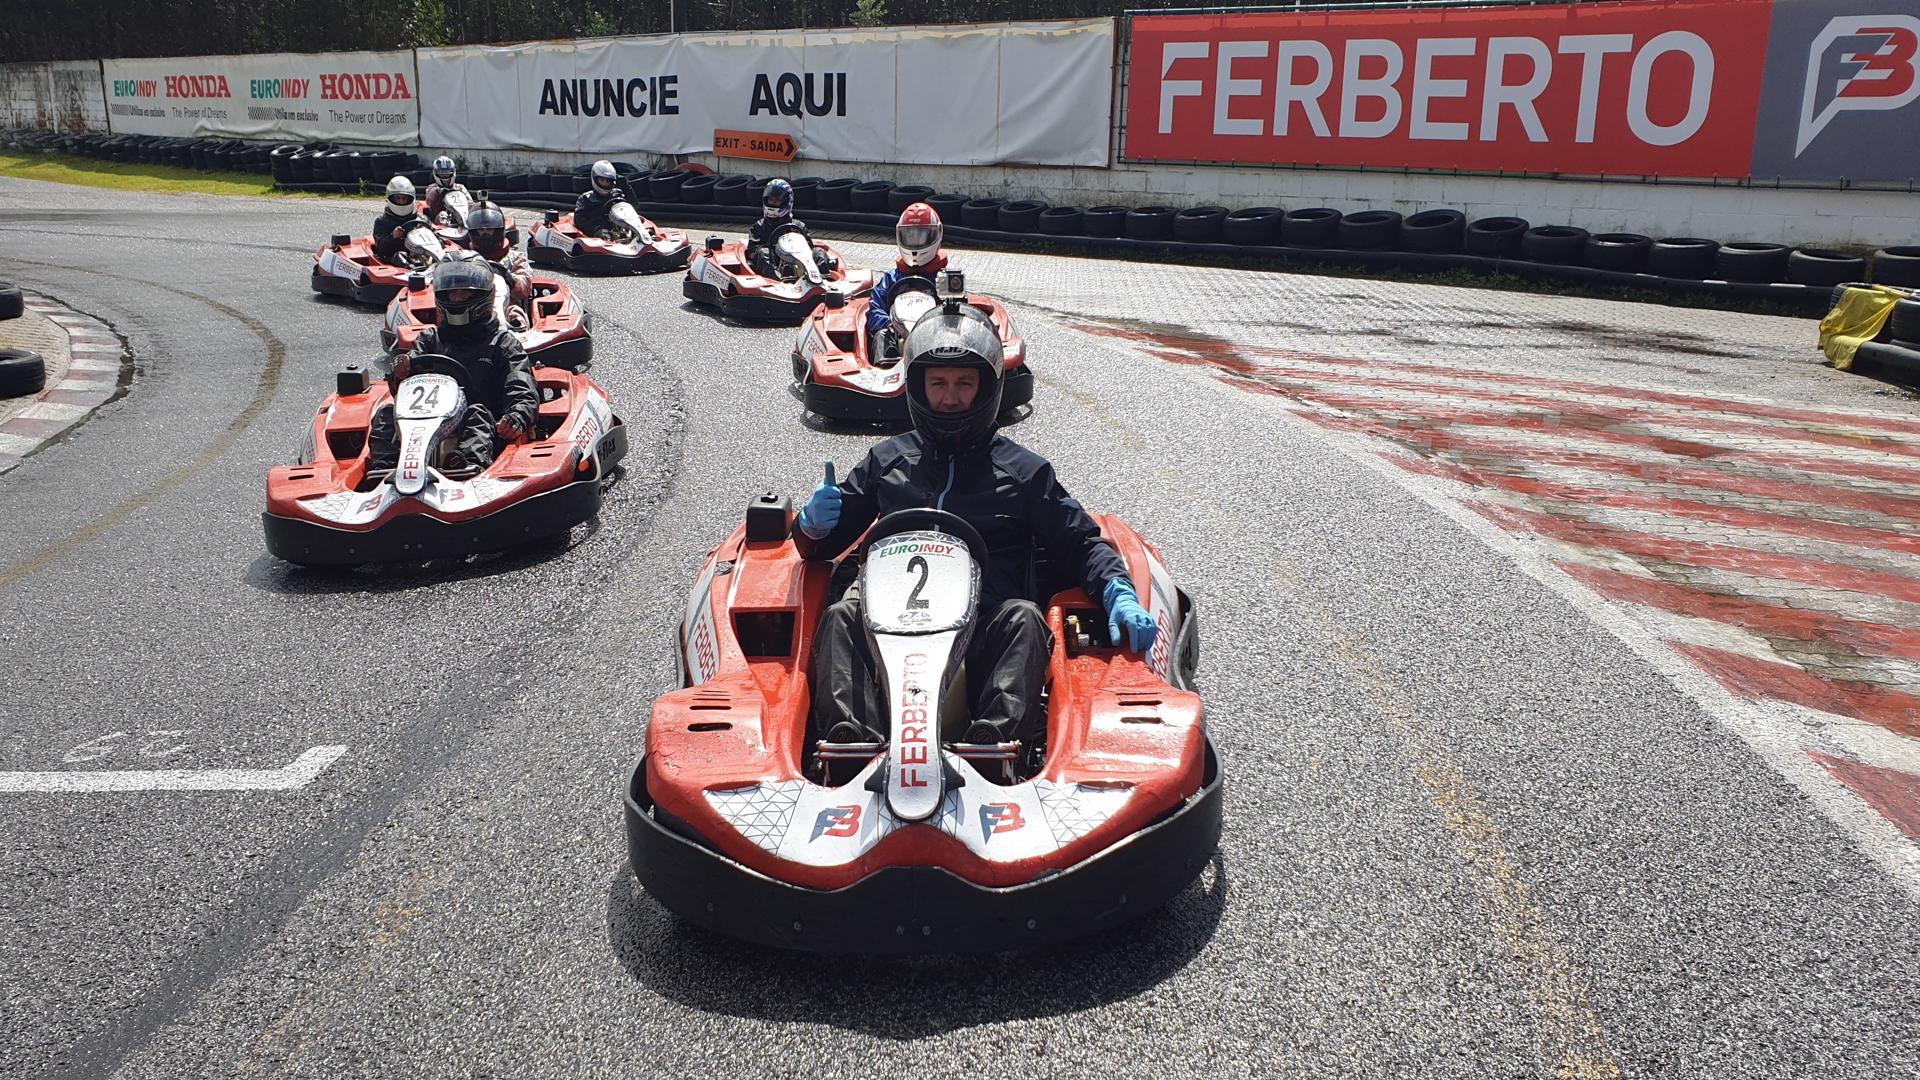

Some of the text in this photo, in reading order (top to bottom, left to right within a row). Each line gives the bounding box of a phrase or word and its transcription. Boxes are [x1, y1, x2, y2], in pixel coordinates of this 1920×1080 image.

[114, 75, 231, 98] EUROINDY HONDA
[250, 73, 411, 100] EUROINDY HONDA
[539, 72, 847, 119] ANUNCIE AQUI
[1158, 30, 1716, 147] FERBERTO
[171, 106, 182, 118] The
[184, 106, 201, 118] Power
[207, 107, 228, 119] Dreams
[328, 109, 343, 123] The
[345, 110, 366, 124] Power
[377, 111, 407, 125] Dreams
[715, 137, 740, 149] EXIT
[750, 138, 783, 153] SAÍDA
[409, 384, 441, 411] 24
[879, 543, 955, 559] EUROINDY
[905, 555, 930, 611] 2
[900, 652, 928, 788] FERBERTO
